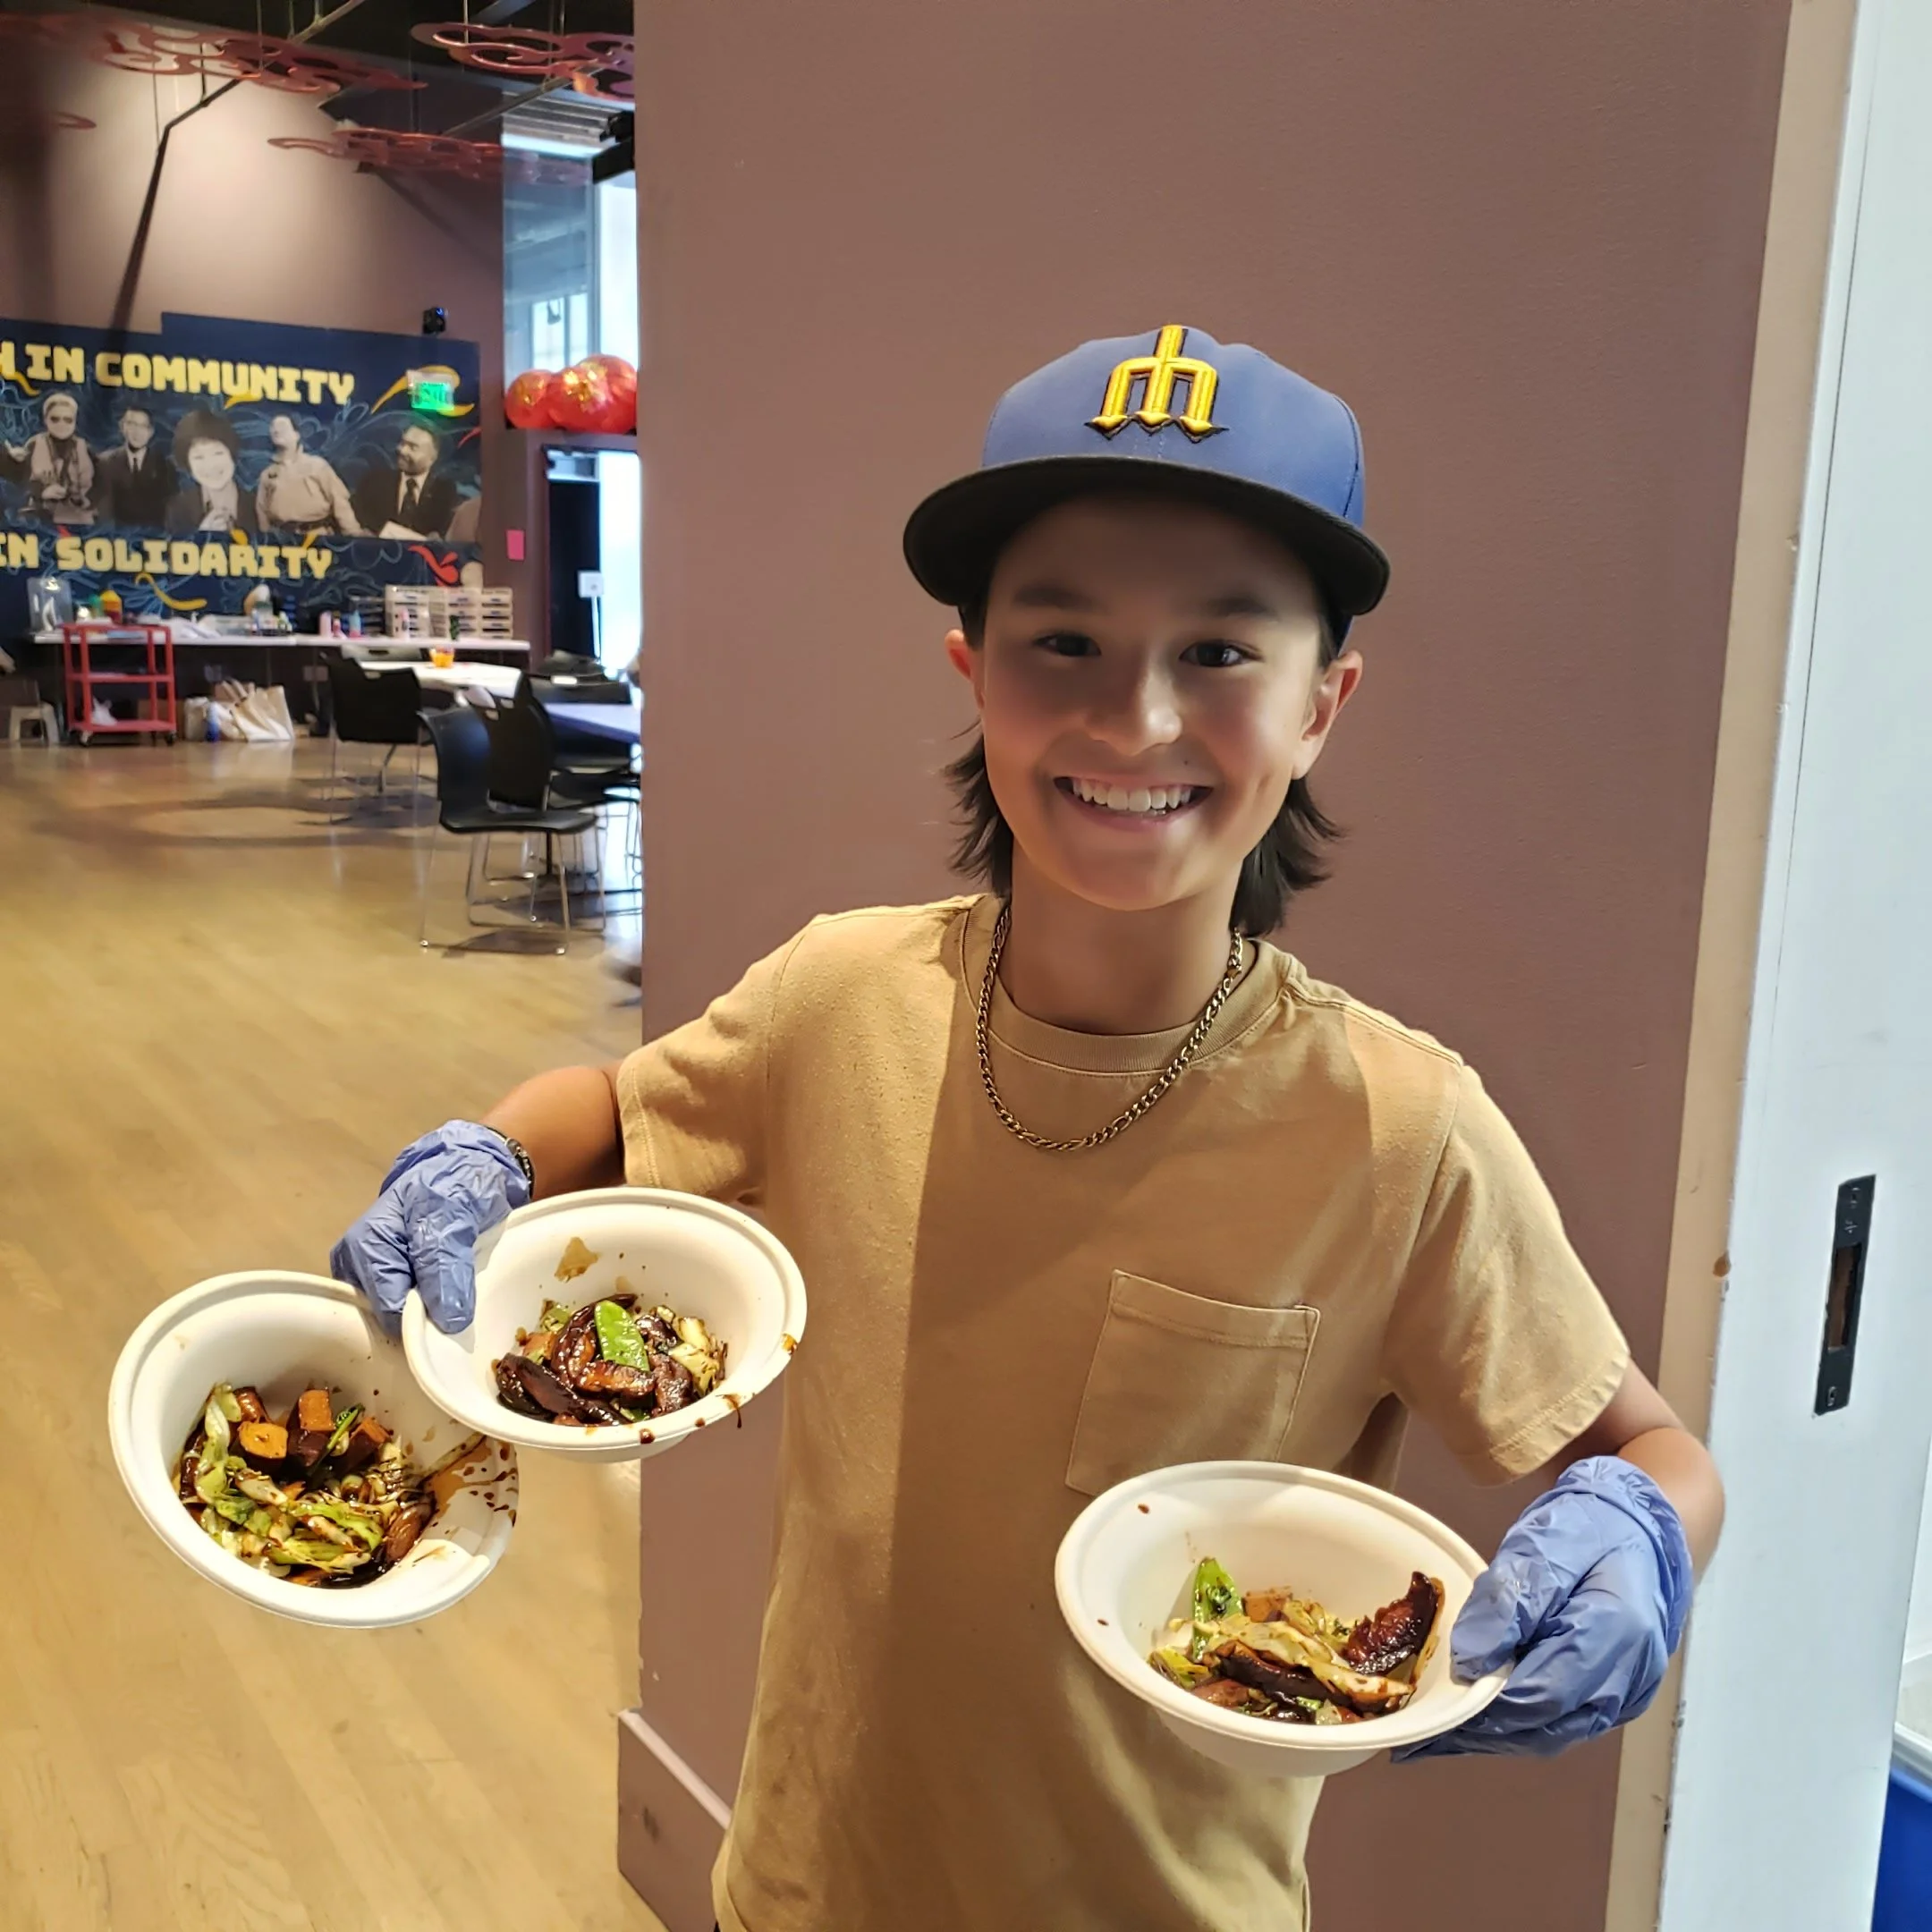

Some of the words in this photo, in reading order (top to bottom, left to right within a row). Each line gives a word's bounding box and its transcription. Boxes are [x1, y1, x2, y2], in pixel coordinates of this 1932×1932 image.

[25, 343, 85, 384] IN
[95, 352, 355, 405] COMMUNITY
[55, 537, 333, 579] SOLIDARITY
